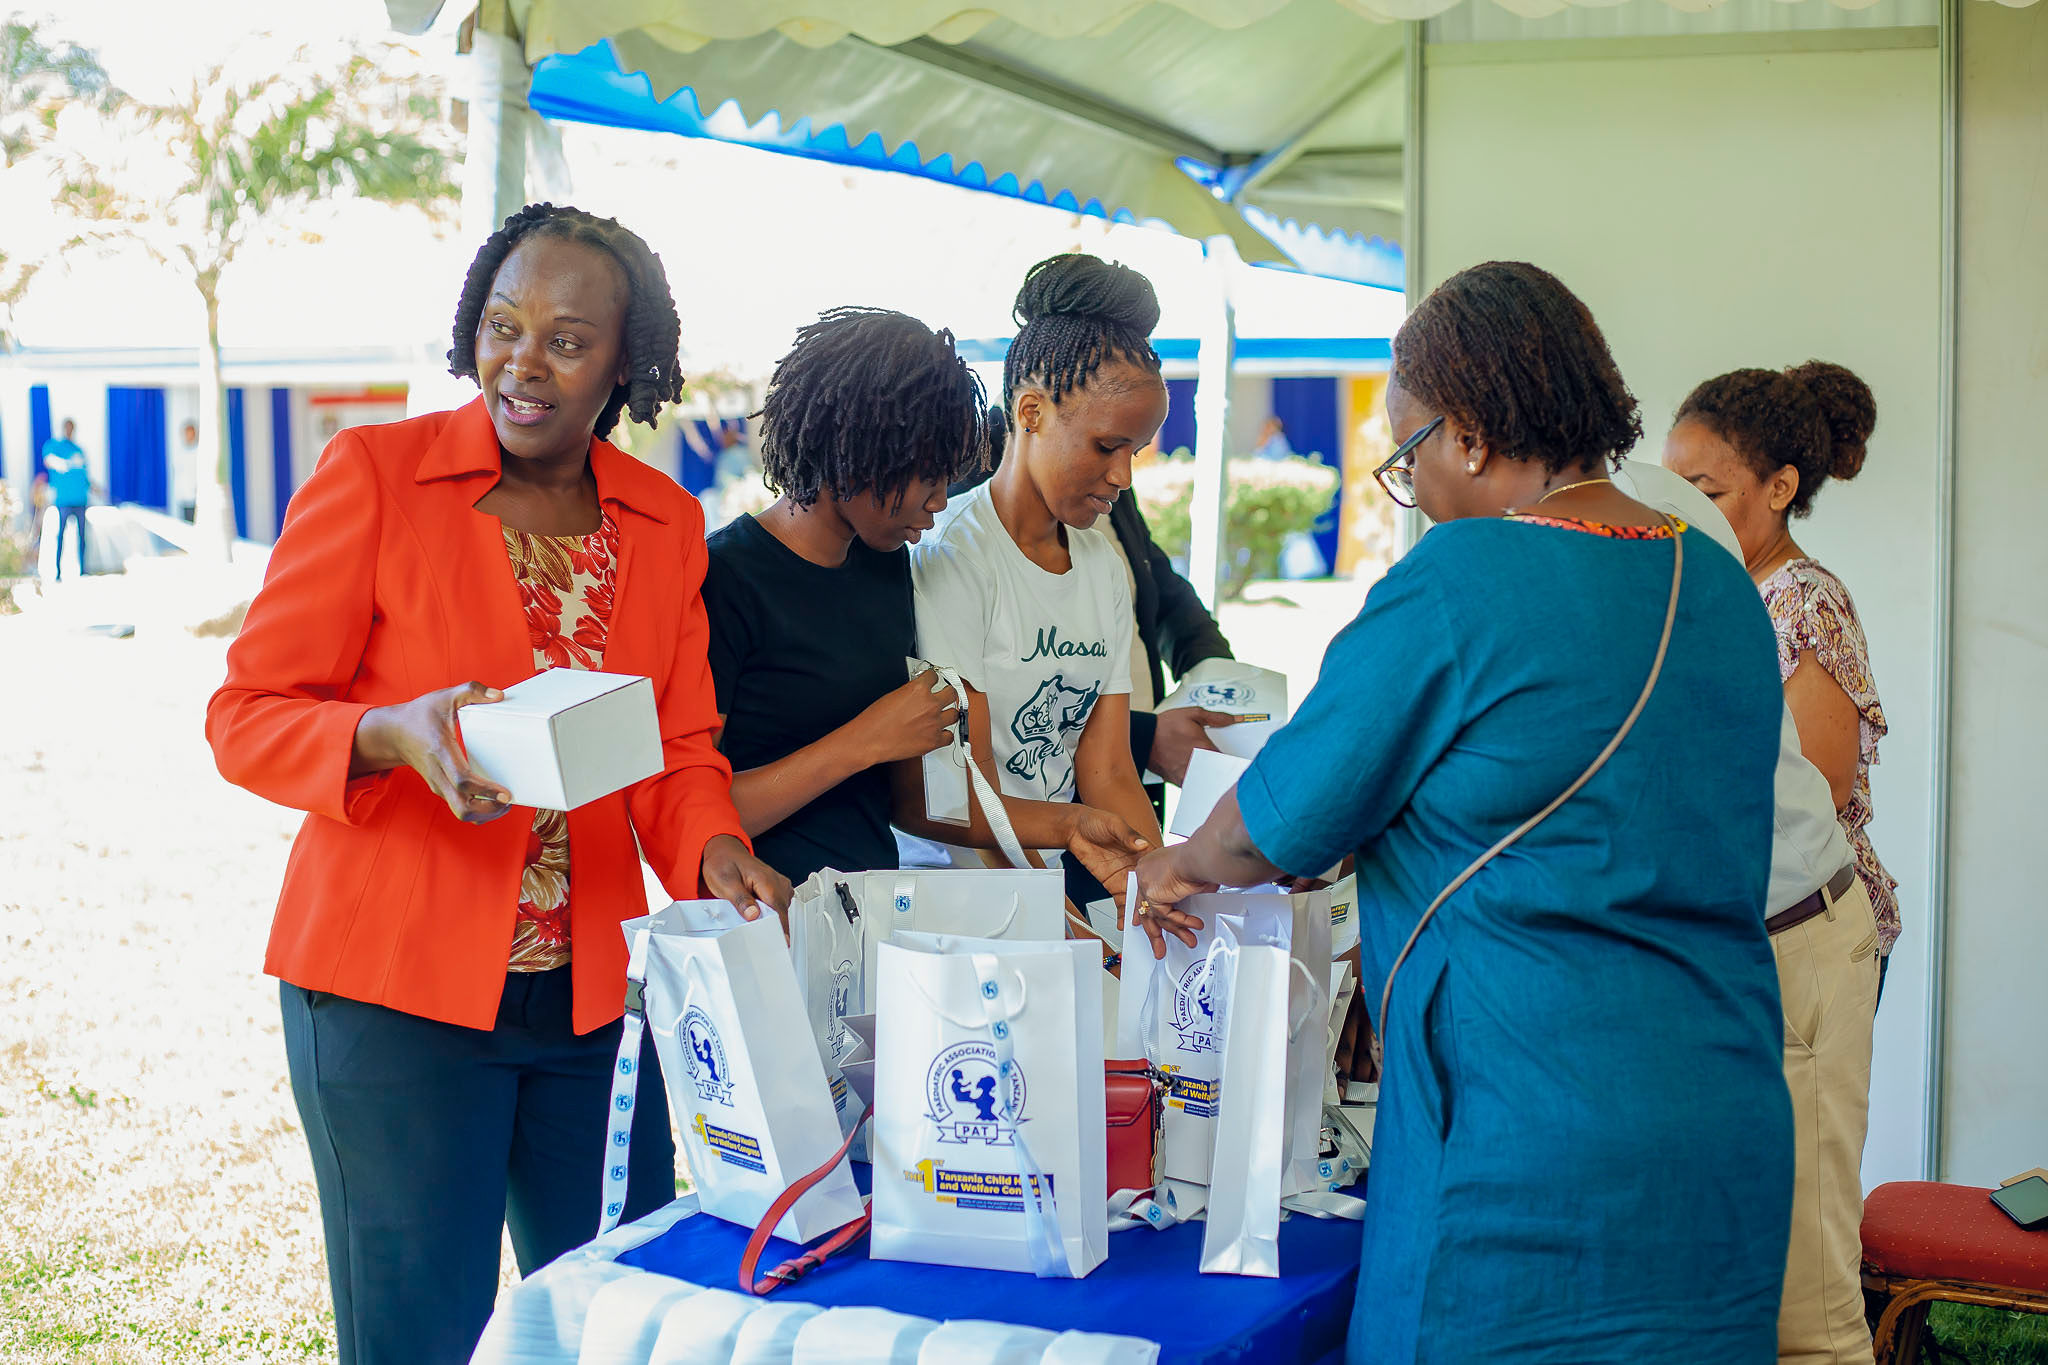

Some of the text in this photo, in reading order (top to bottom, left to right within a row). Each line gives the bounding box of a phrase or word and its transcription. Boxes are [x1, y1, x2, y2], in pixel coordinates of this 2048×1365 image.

[1021, 625, 1107, 662] Masai
[1198, 1035, 1212, 1047] PA
[944, 1047, 997, 1065] ASSOCIATIO
[962, 1126, 989, 1137] PAT
[939, 1171, 983, 1184] Tanzania
[985, 1174, 1012, 1186] Child
[939, 1181, 959, 1191] and
[960, 1183, 1000, 1195] Welfare
